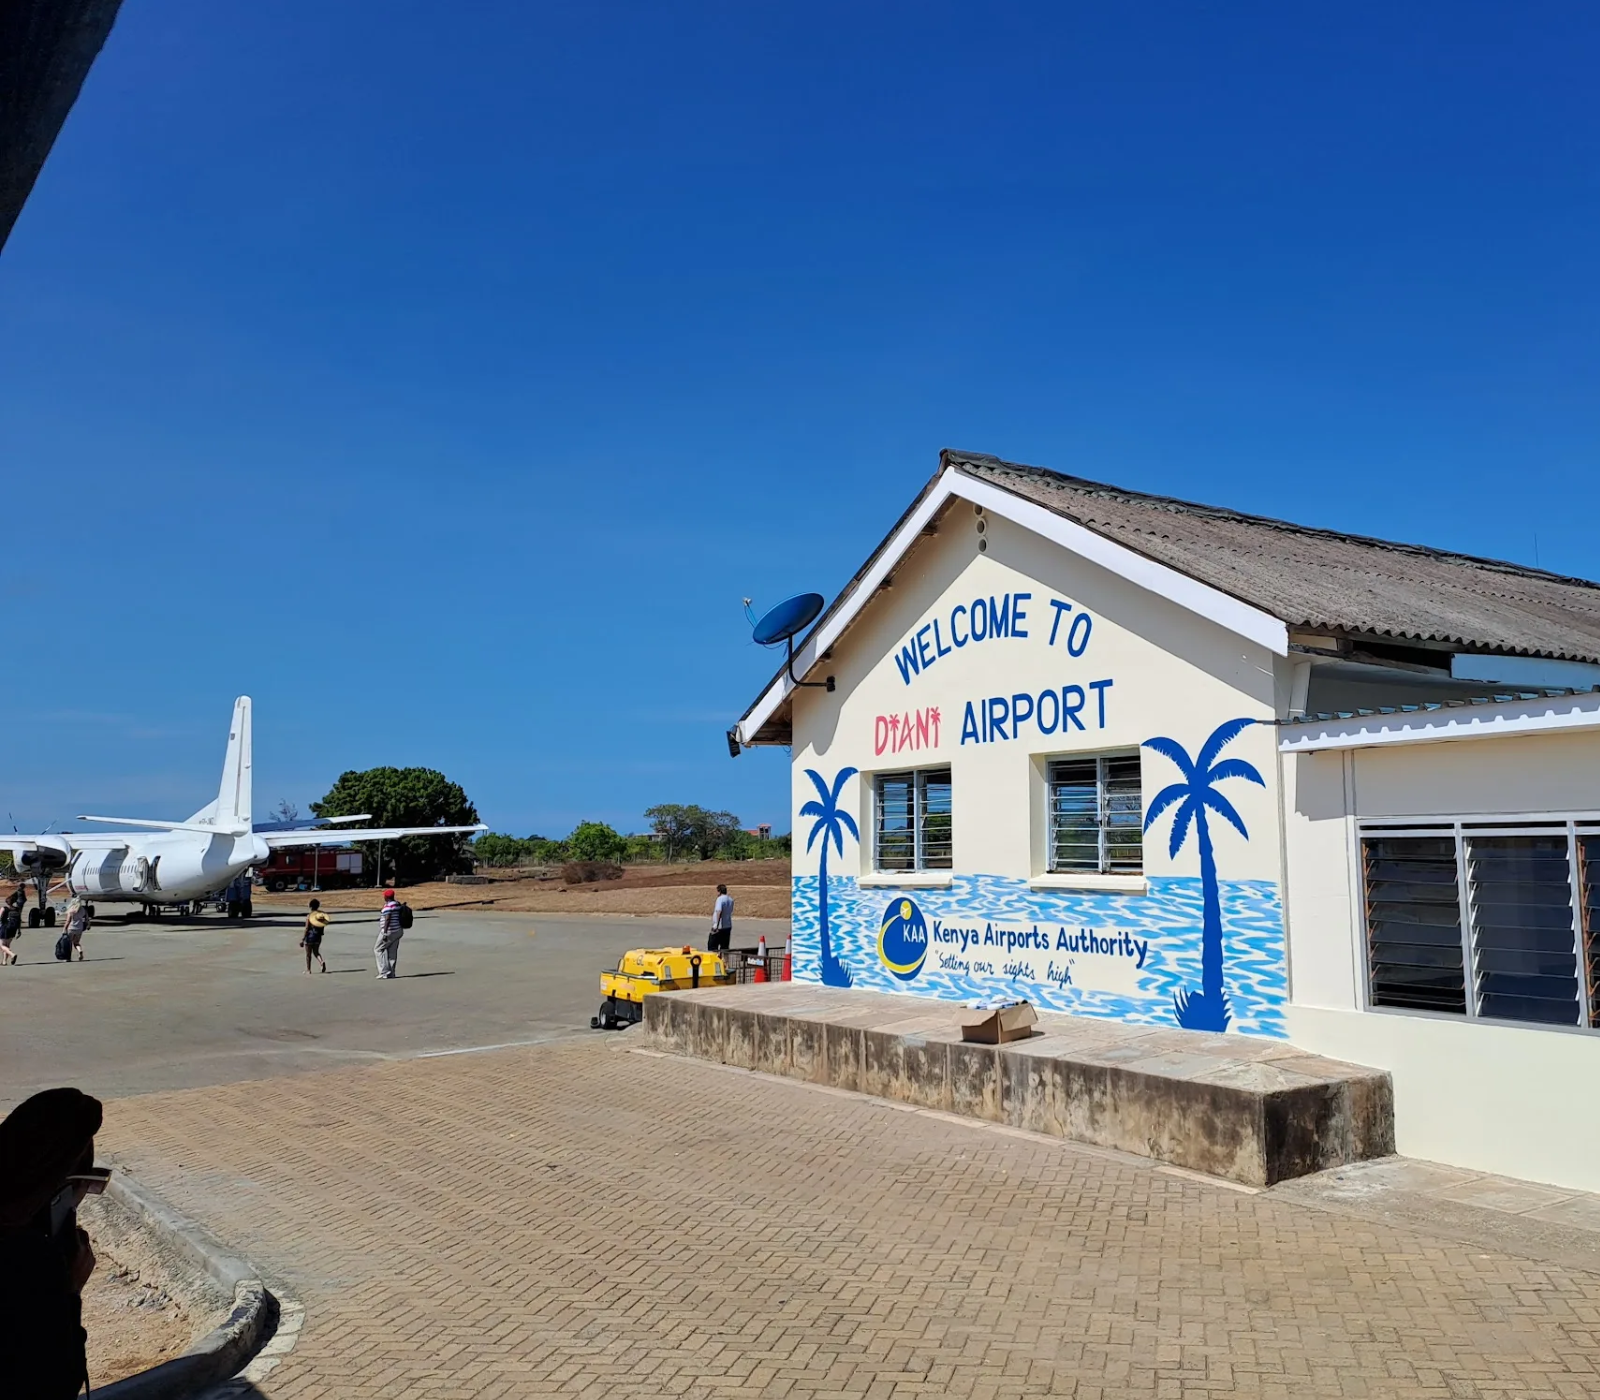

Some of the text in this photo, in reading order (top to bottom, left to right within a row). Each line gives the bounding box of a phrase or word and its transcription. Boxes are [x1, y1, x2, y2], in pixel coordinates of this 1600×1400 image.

[894, 593, 1092, 686] WELCOME TO
[960, 678, 1113, 745] AIRPORT
[903, 923, 926, 943] KAA
[933, 920, 1148, 969] Kenya Airports Authority
[973, 961, 994, 975] our
[1002, 959, 1035, 983] sights
